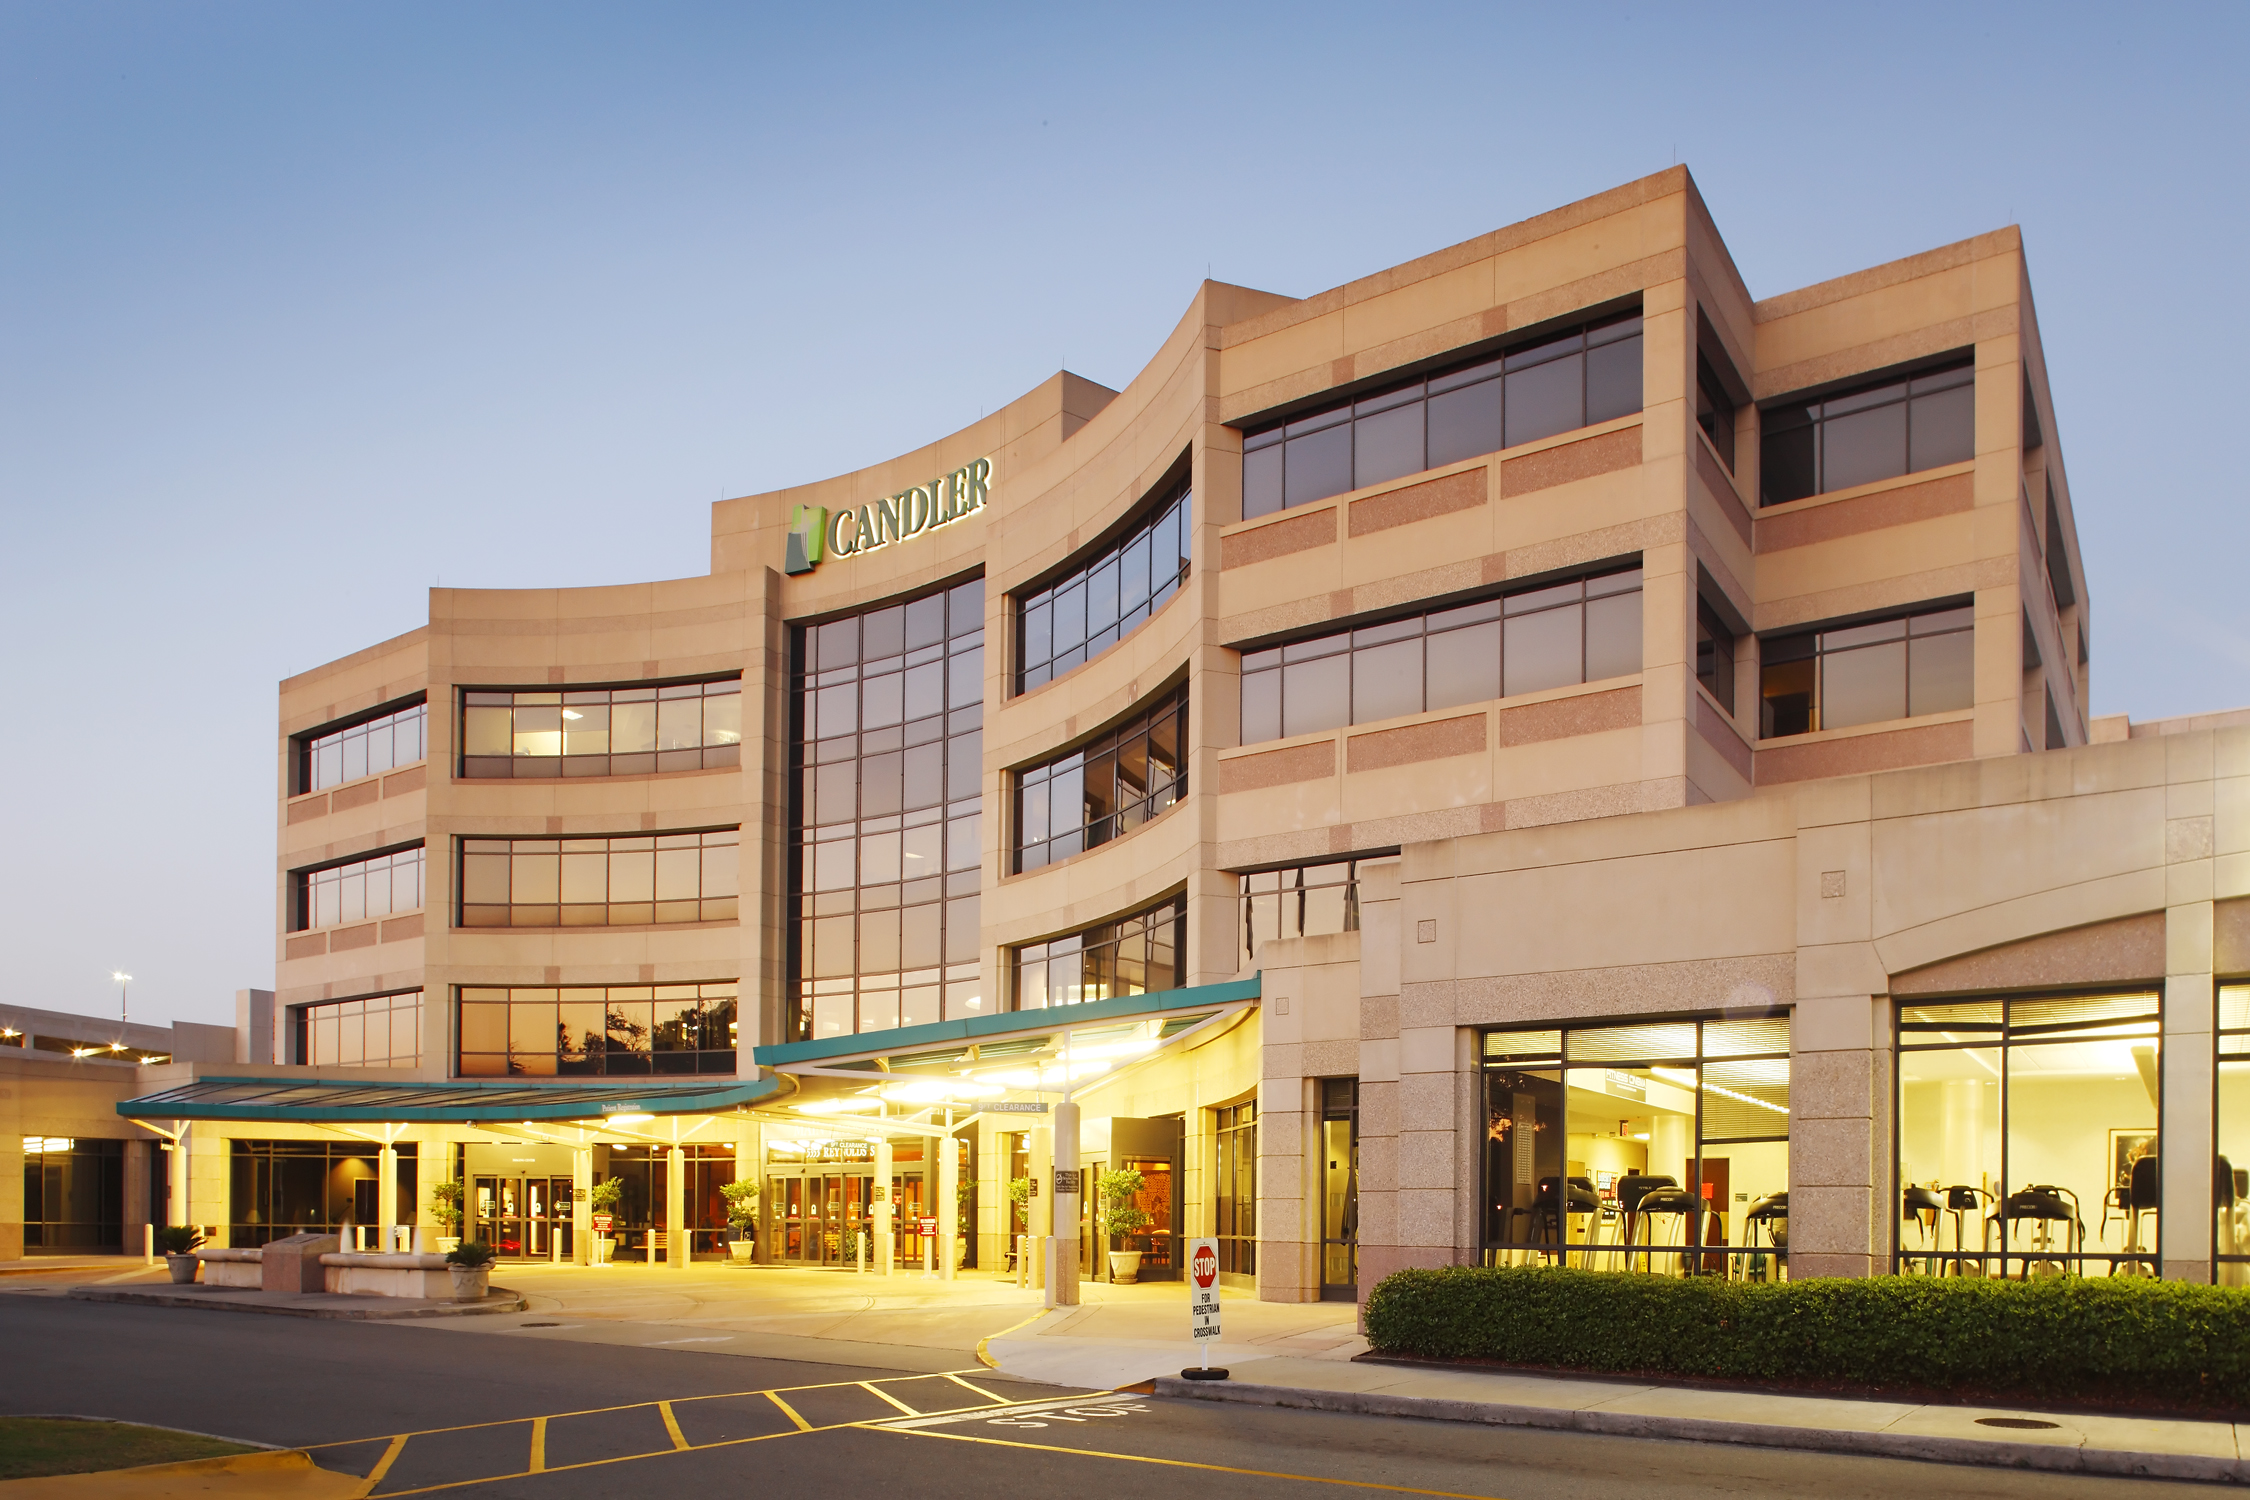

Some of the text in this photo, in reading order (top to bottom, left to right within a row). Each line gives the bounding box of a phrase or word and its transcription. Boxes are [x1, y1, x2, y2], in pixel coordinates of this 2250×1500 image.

[828, 457, 991, 557] CANDLER
[993, 1103, 1042, 1112] CLEARANCE
[1194, 1257, 1215, 1277] STOP
[1201, 1293, 1211, 1303] FOR
[1193, 1303, 1220, 1315] PEDESTRIAN
[1204, 1315, 1210, 1326] IN
[1194, 1325, 1221, 1338] CROSSWALK
[986, 1403, 1153, 1428] STOP
